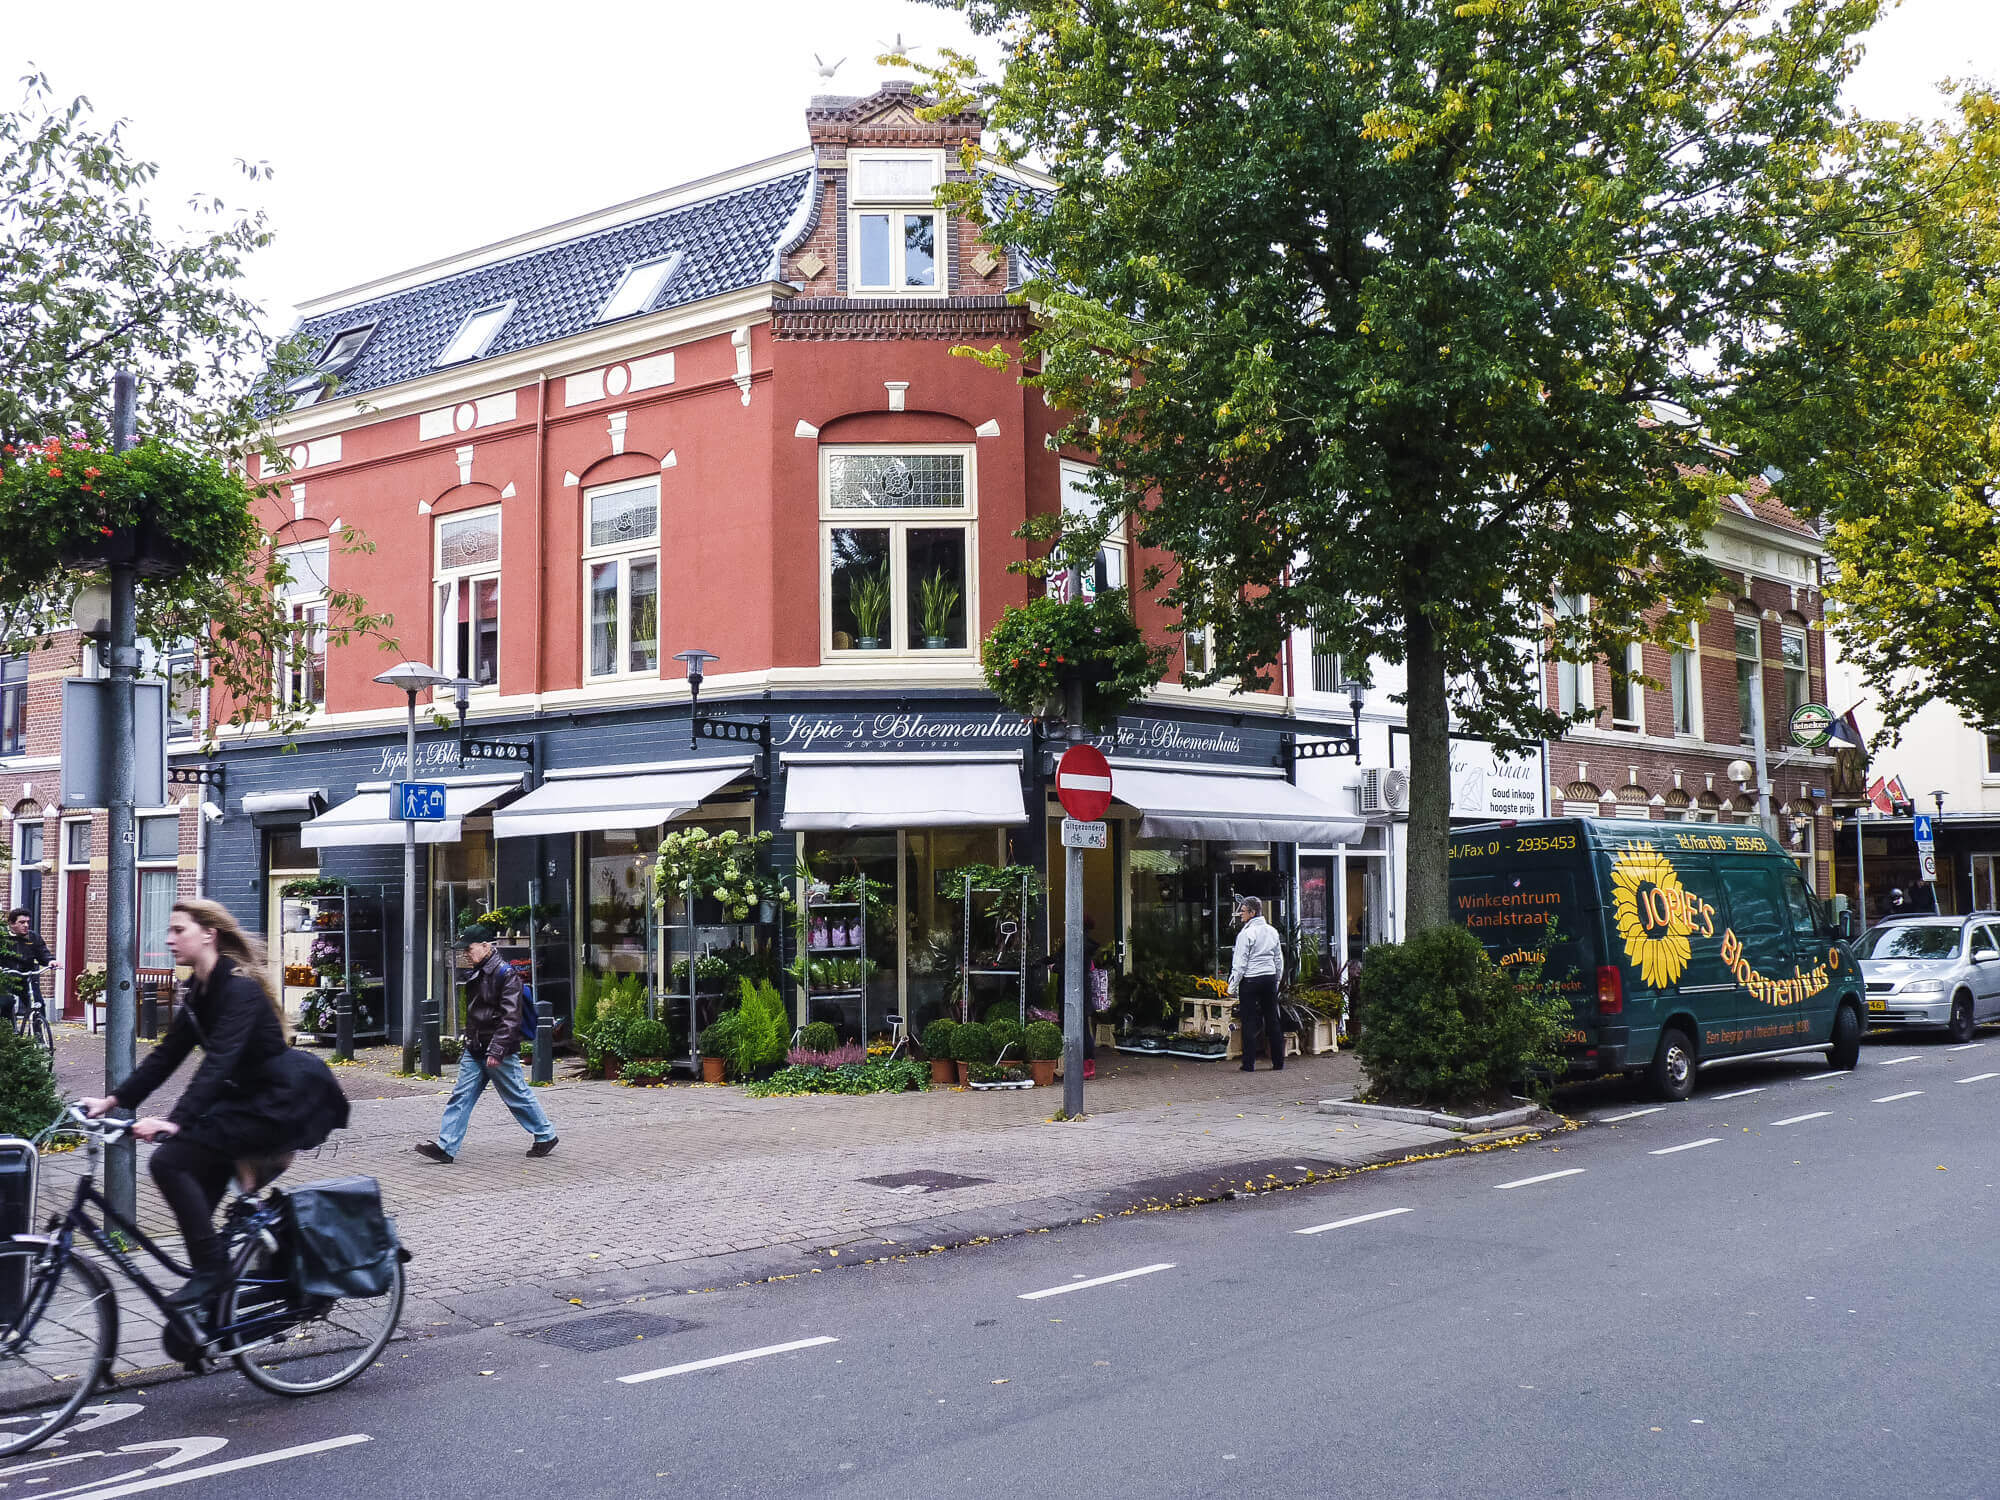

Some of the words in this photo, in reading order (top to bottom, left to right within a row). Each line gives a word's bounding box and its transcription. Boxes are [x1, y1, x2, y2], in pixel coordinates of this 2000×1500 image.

[872, 714, 1032, 738] Bloemenhuis
[1151, 721, 1240, 753] Bloemenhuis
[1487, 757, 1530, 780] Sinan
[1492, 788, 1511, 799] Goud
[1511, 788, 1535, 800] inkoop
[1490, 802, 1518, 815] hoogste
[1519, 804, 1535, 816] prijs
[1448, 844, 1484, 859] el./Fax
[1517, 835, 1576, 852] 2935453
[1641, 887, 1715, 938] JOPIE'S
[1720, 927, 1829, 1006] Bloemenhuis
[1560, 1029, 1587, 1043] 930
